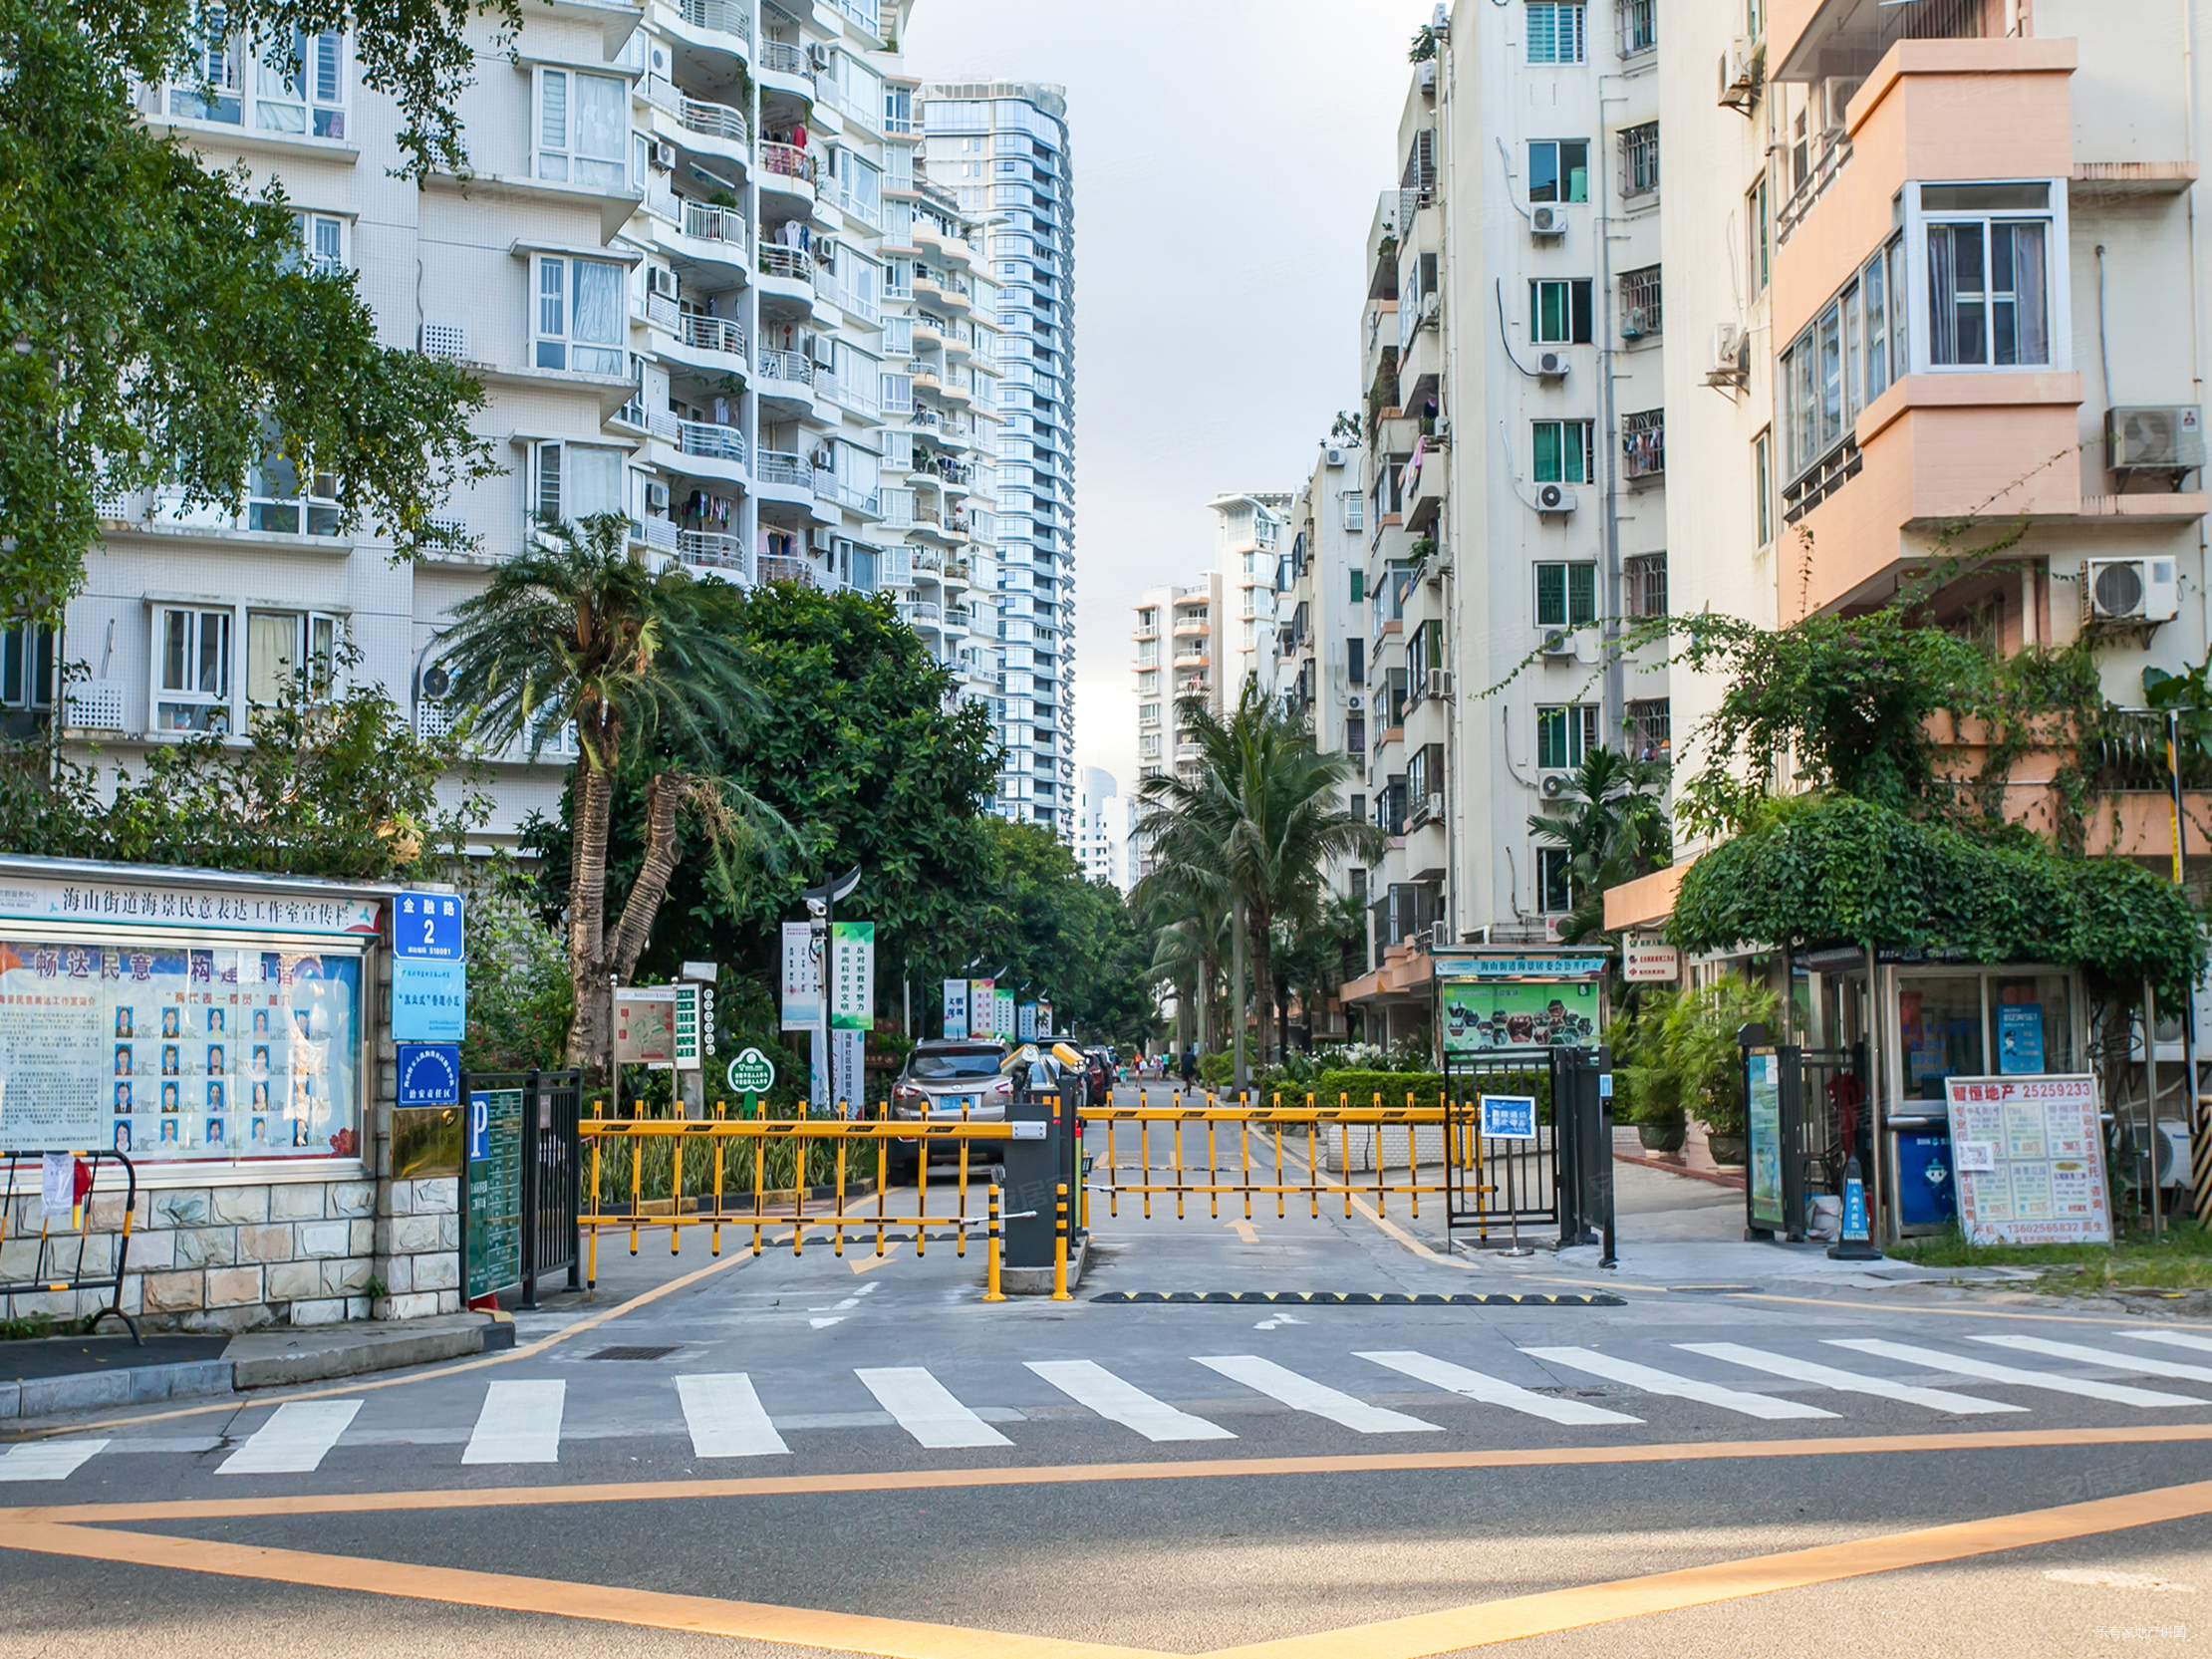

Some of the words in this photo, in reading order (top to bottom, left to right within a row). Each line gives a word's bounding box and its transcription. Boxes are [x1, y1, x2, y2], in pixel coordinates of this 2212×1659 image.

[64, 886, 350, 927] 海山街道海景民意表达工作室宣传栏
[403, 898, 455, 917] 金融路
[423, 919, 435, 945] 2
[35, 951, 152, 981] 畅达民意
[191, 957, 296, 985] 构建和谐
[409, 1088, 451, 1100] 治安责任区
[1952, 1084, 2015, 1101] 智恒地产
[2023, 1083, 2090, 1098] 25259233
[470, 1100, 488, 1158] P
[2008, 1224, 2078, 1234] 13602565832
[2081, 1222, 2104, 1233] 周生
